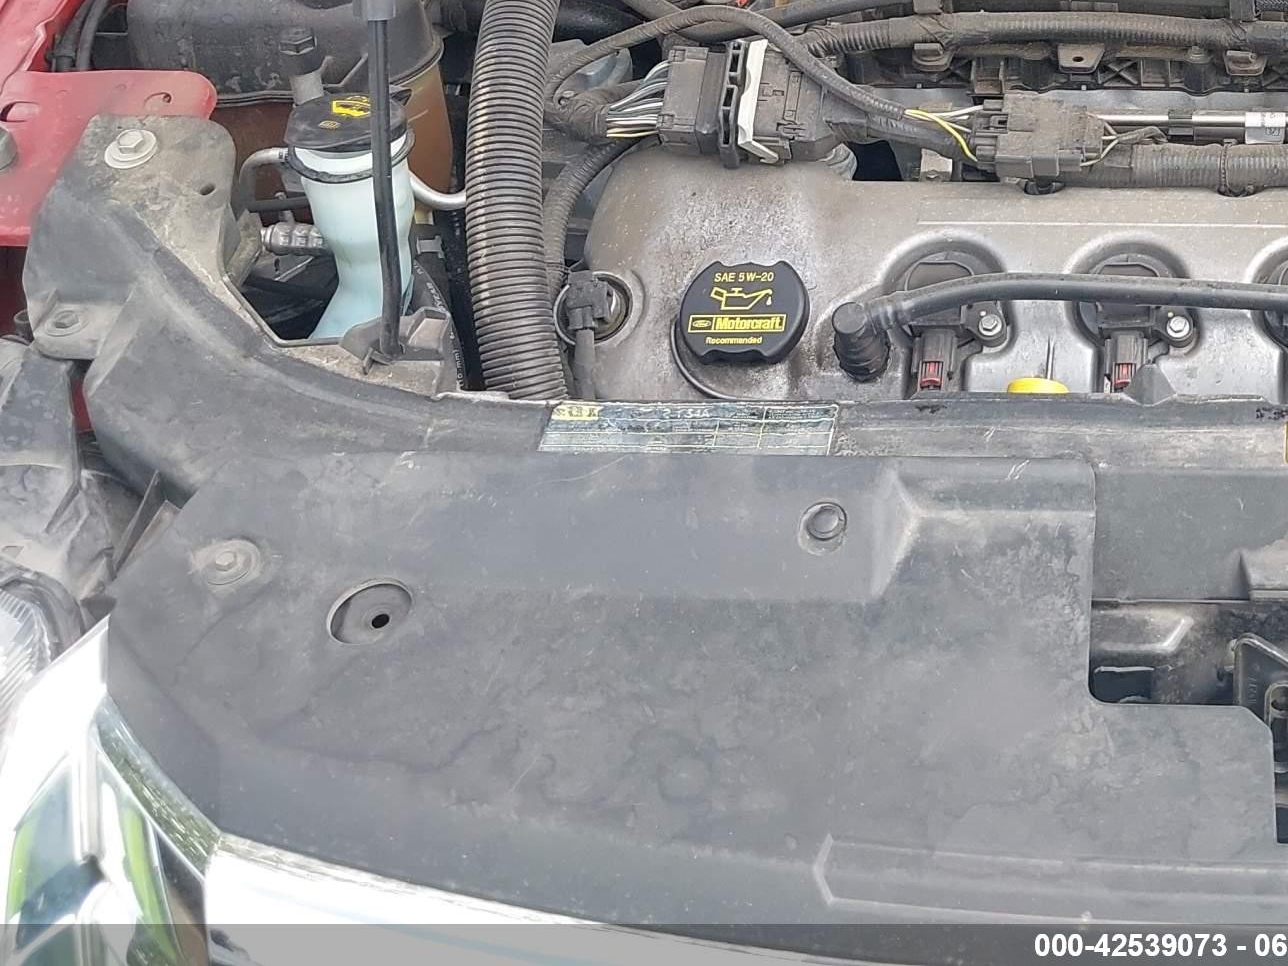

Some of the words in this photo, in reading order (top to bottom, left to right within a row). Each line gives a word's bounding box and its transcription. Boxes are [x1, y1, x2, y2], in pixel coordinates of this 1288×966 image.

[714, 272, 737, 282] SAE
[738, 271, 775, 282] 5W-20
[715, 316, 783, 330] Motorcraft
[705, 336, 763, 345] Recommended
